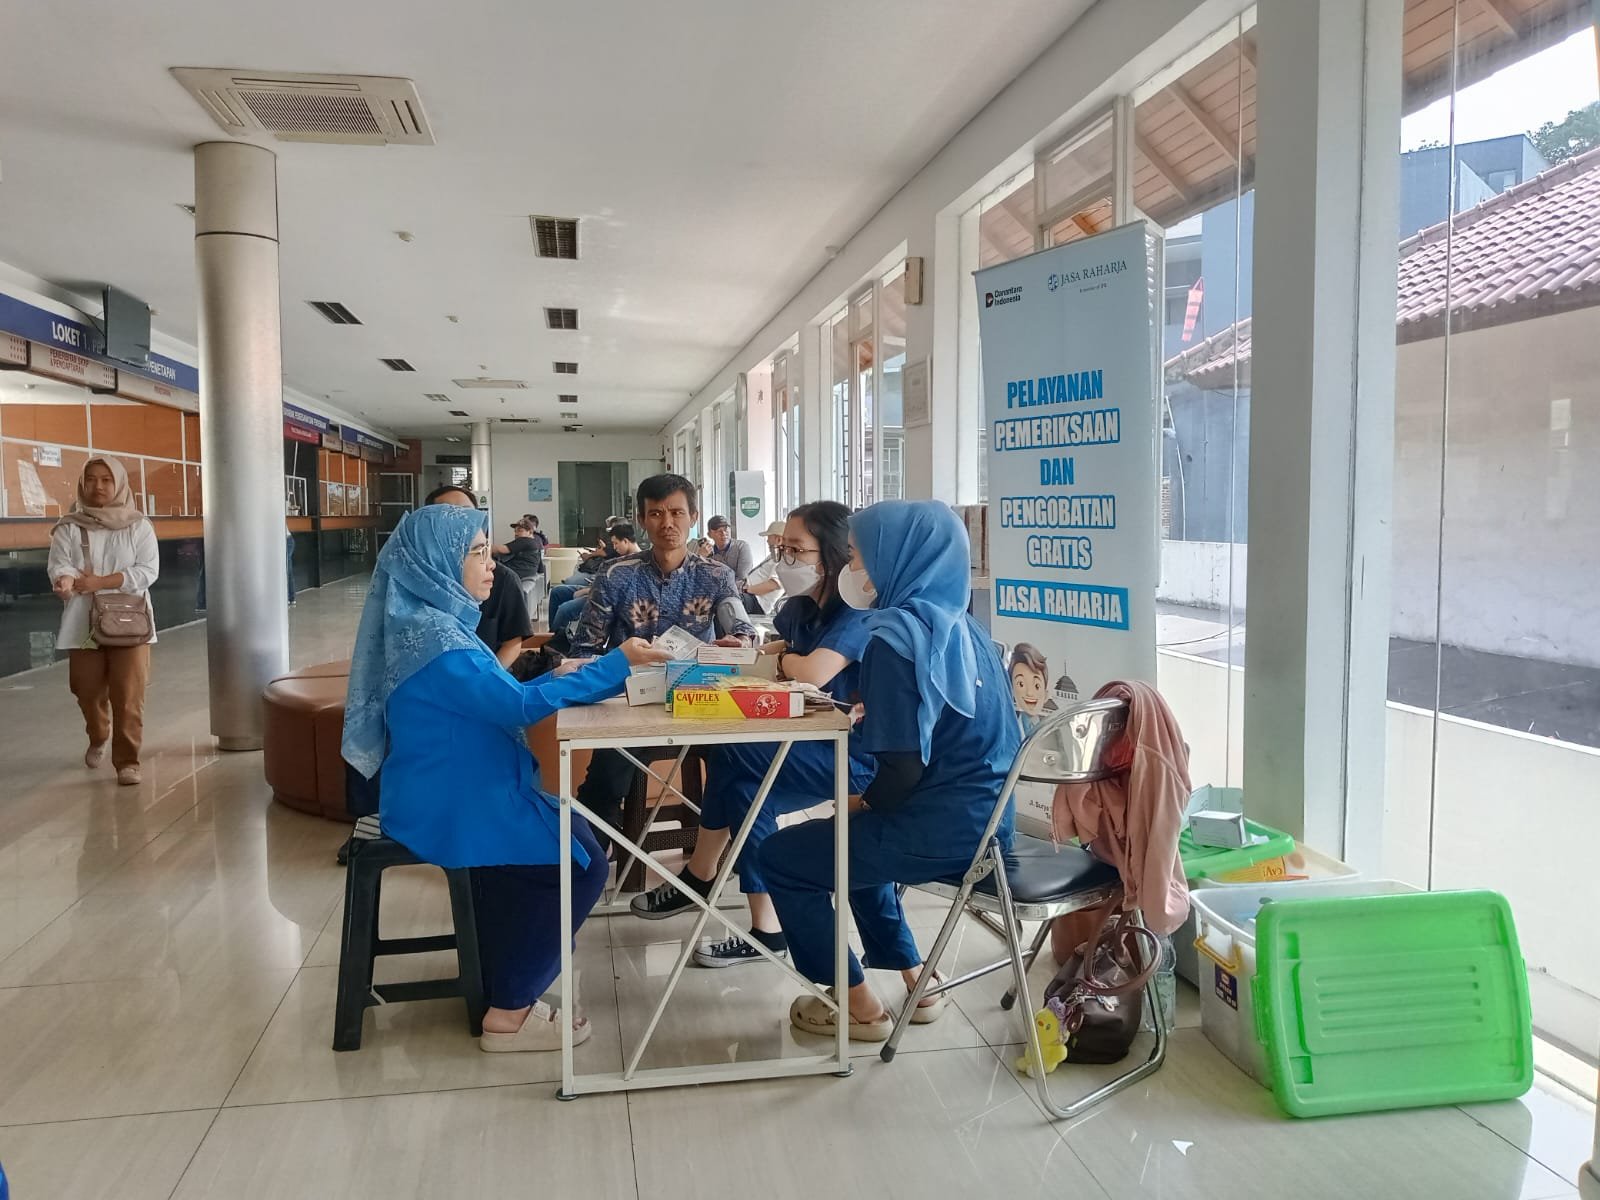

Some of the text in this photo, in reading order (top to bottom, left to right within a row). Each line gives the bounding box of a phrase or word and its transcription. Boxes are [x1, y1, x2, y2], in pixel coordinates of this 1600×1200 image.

[1060, 260, 1127, 287] JASA RAHARJA
[994, 294, 1021, 306] Indonesia
[52, 321, 80, 347] LOKET
[1007, 370, 1103, 408] PELAYANAN
[995, 409, 1119, 451] PEMERIKSAAN
[1040, 457, 1074, 485] DAN
[1001, 496, 1115, 528] PENGOBATAN
[1027, 535, 1092, 570] GRATIS
[999, 585, 1123, 623] JASA RAHARJA
[676, 693, 719, 706] CAVIPLEX
